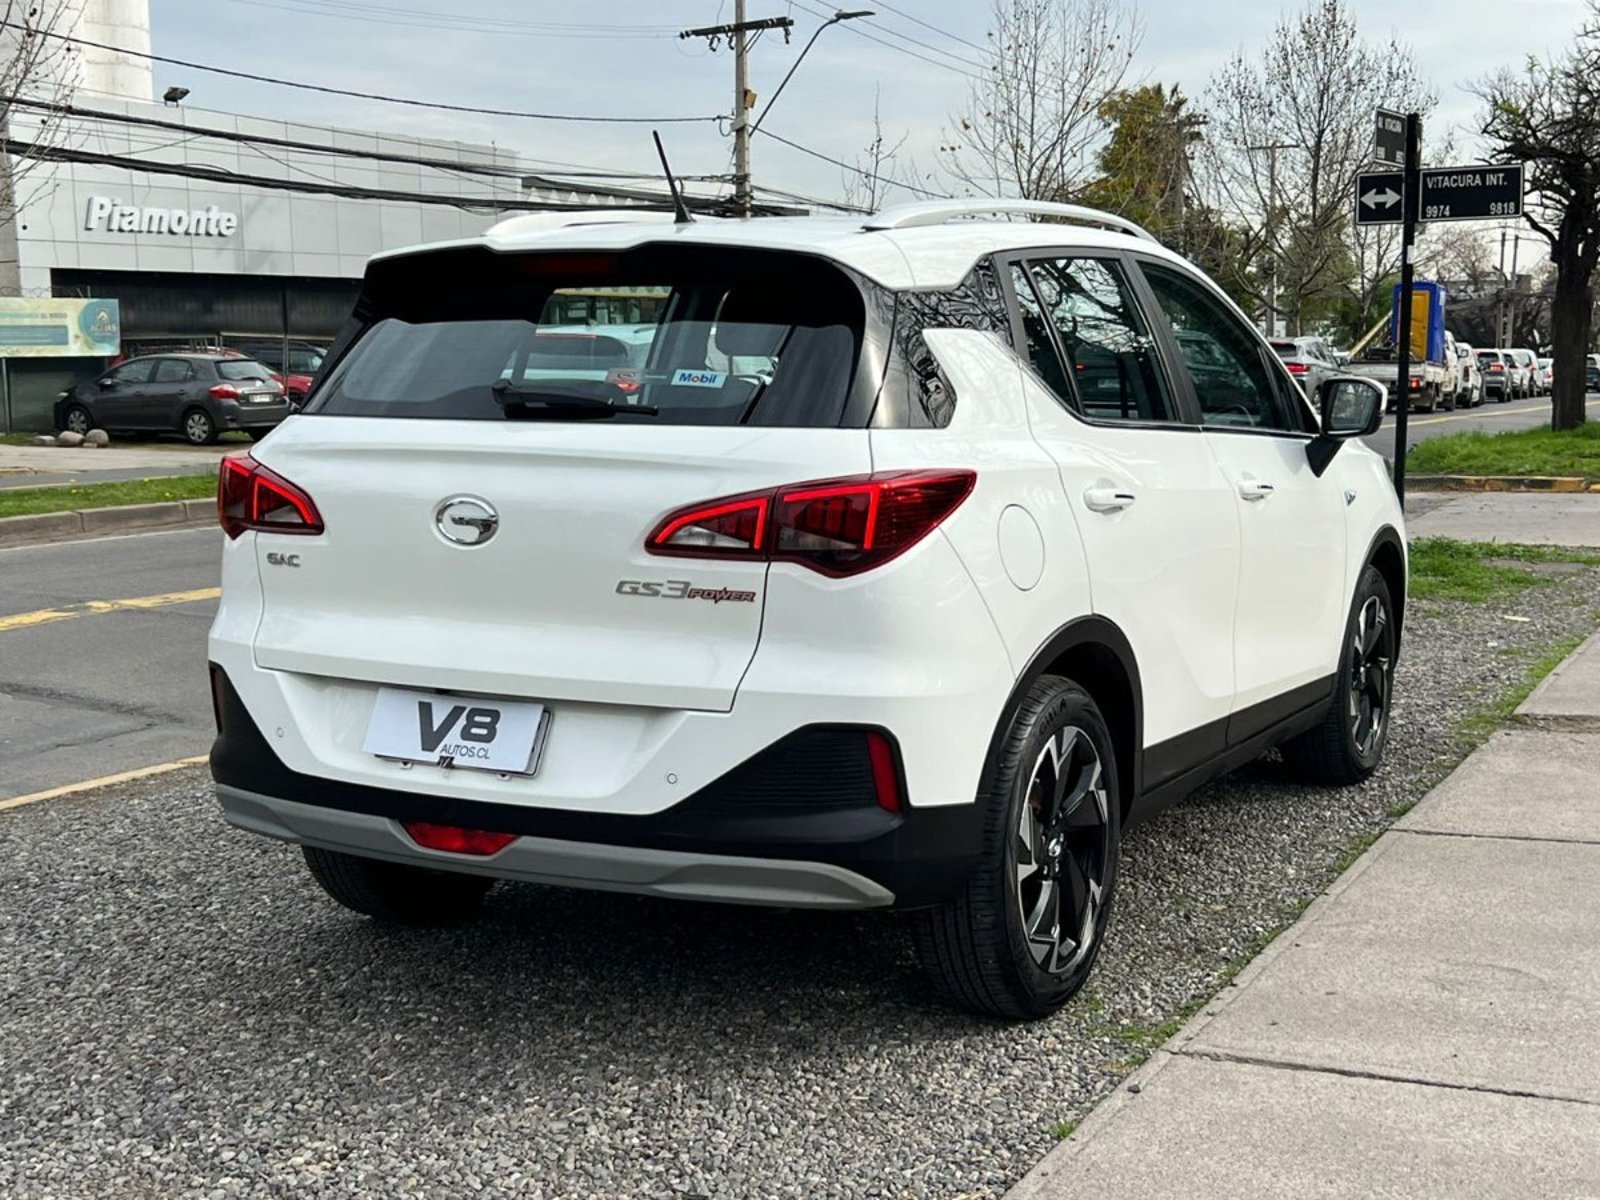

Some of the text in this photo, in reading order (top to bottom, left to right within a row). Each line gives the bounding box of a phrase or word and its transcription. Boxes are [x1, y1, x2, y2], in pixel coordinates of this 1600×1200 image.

[1426, 173, 1508, 189] VITACURA INT.
[85, 196, 238, 236] Piamonte
[1489, 202, 1515, 215] 9818
[679, 373, 717, 384] Mobil
[266, 552, 300, 567] GAC
[615, 580, 691, 599] GS3
[418, 701, 501, 752] V8
[440, 743, 490, 759] AUTOS.CL
